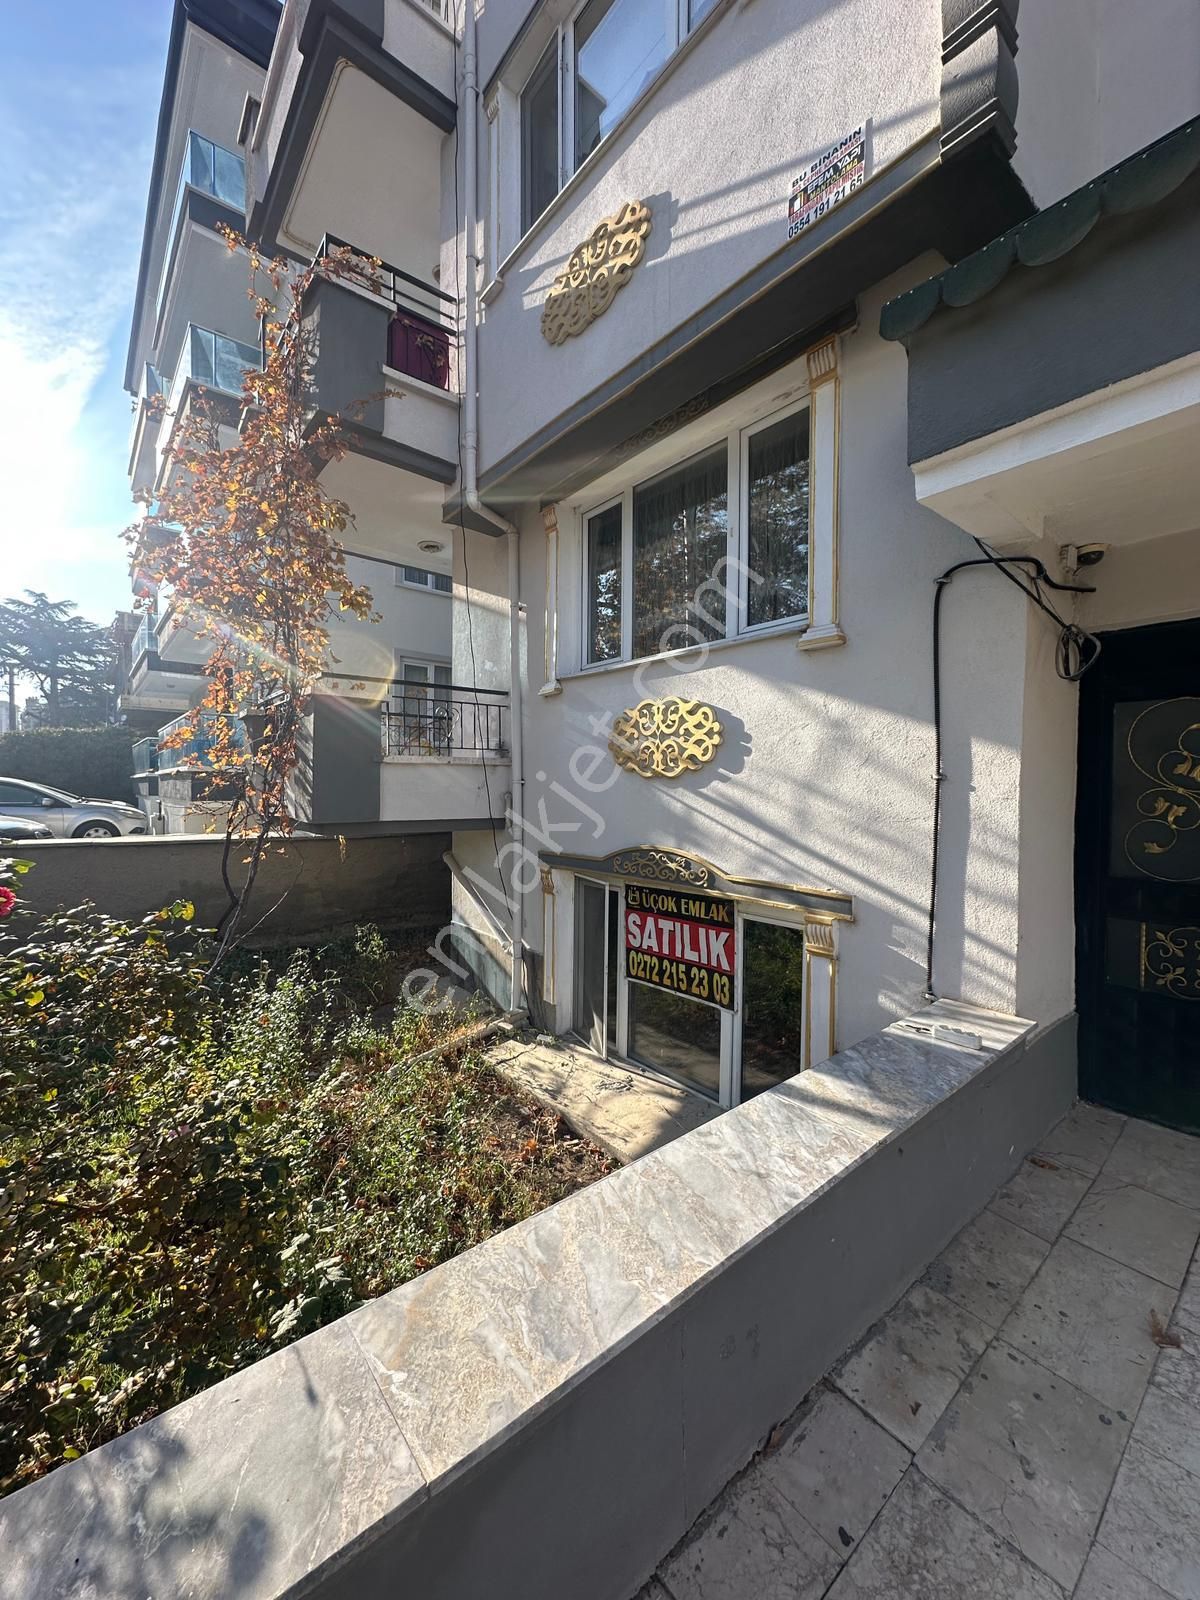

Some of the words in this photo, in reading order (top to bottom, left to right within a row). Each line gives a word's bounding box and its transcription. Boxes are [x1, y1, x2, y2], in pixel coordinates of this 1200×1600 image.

[807, 167, 834, 194] EFEM
[837, 145, 861, 169] YAPI
[823, 136, 862, 171] KAPLAMASI
[792, 171, 807, 188] BU
[809, 159, 858, 200] MANTOLAMA
[788, 213, 810, 239] 0554
[813, 197, 830, 219] 191
[833, 188, 846, 204] 21
[849, 174, 863, 192] 65
[642, 889, 677, 913] ÜÇOK
[680, 899, 729, 922] EMLAK
[627, 913, 731, 971] SATILIK
[629, 950, 659, 982] 0272
[662, 959, 688, 992] 215
[690, 966, 710, 998] 23
[712, 972, 730, 1006] 03
